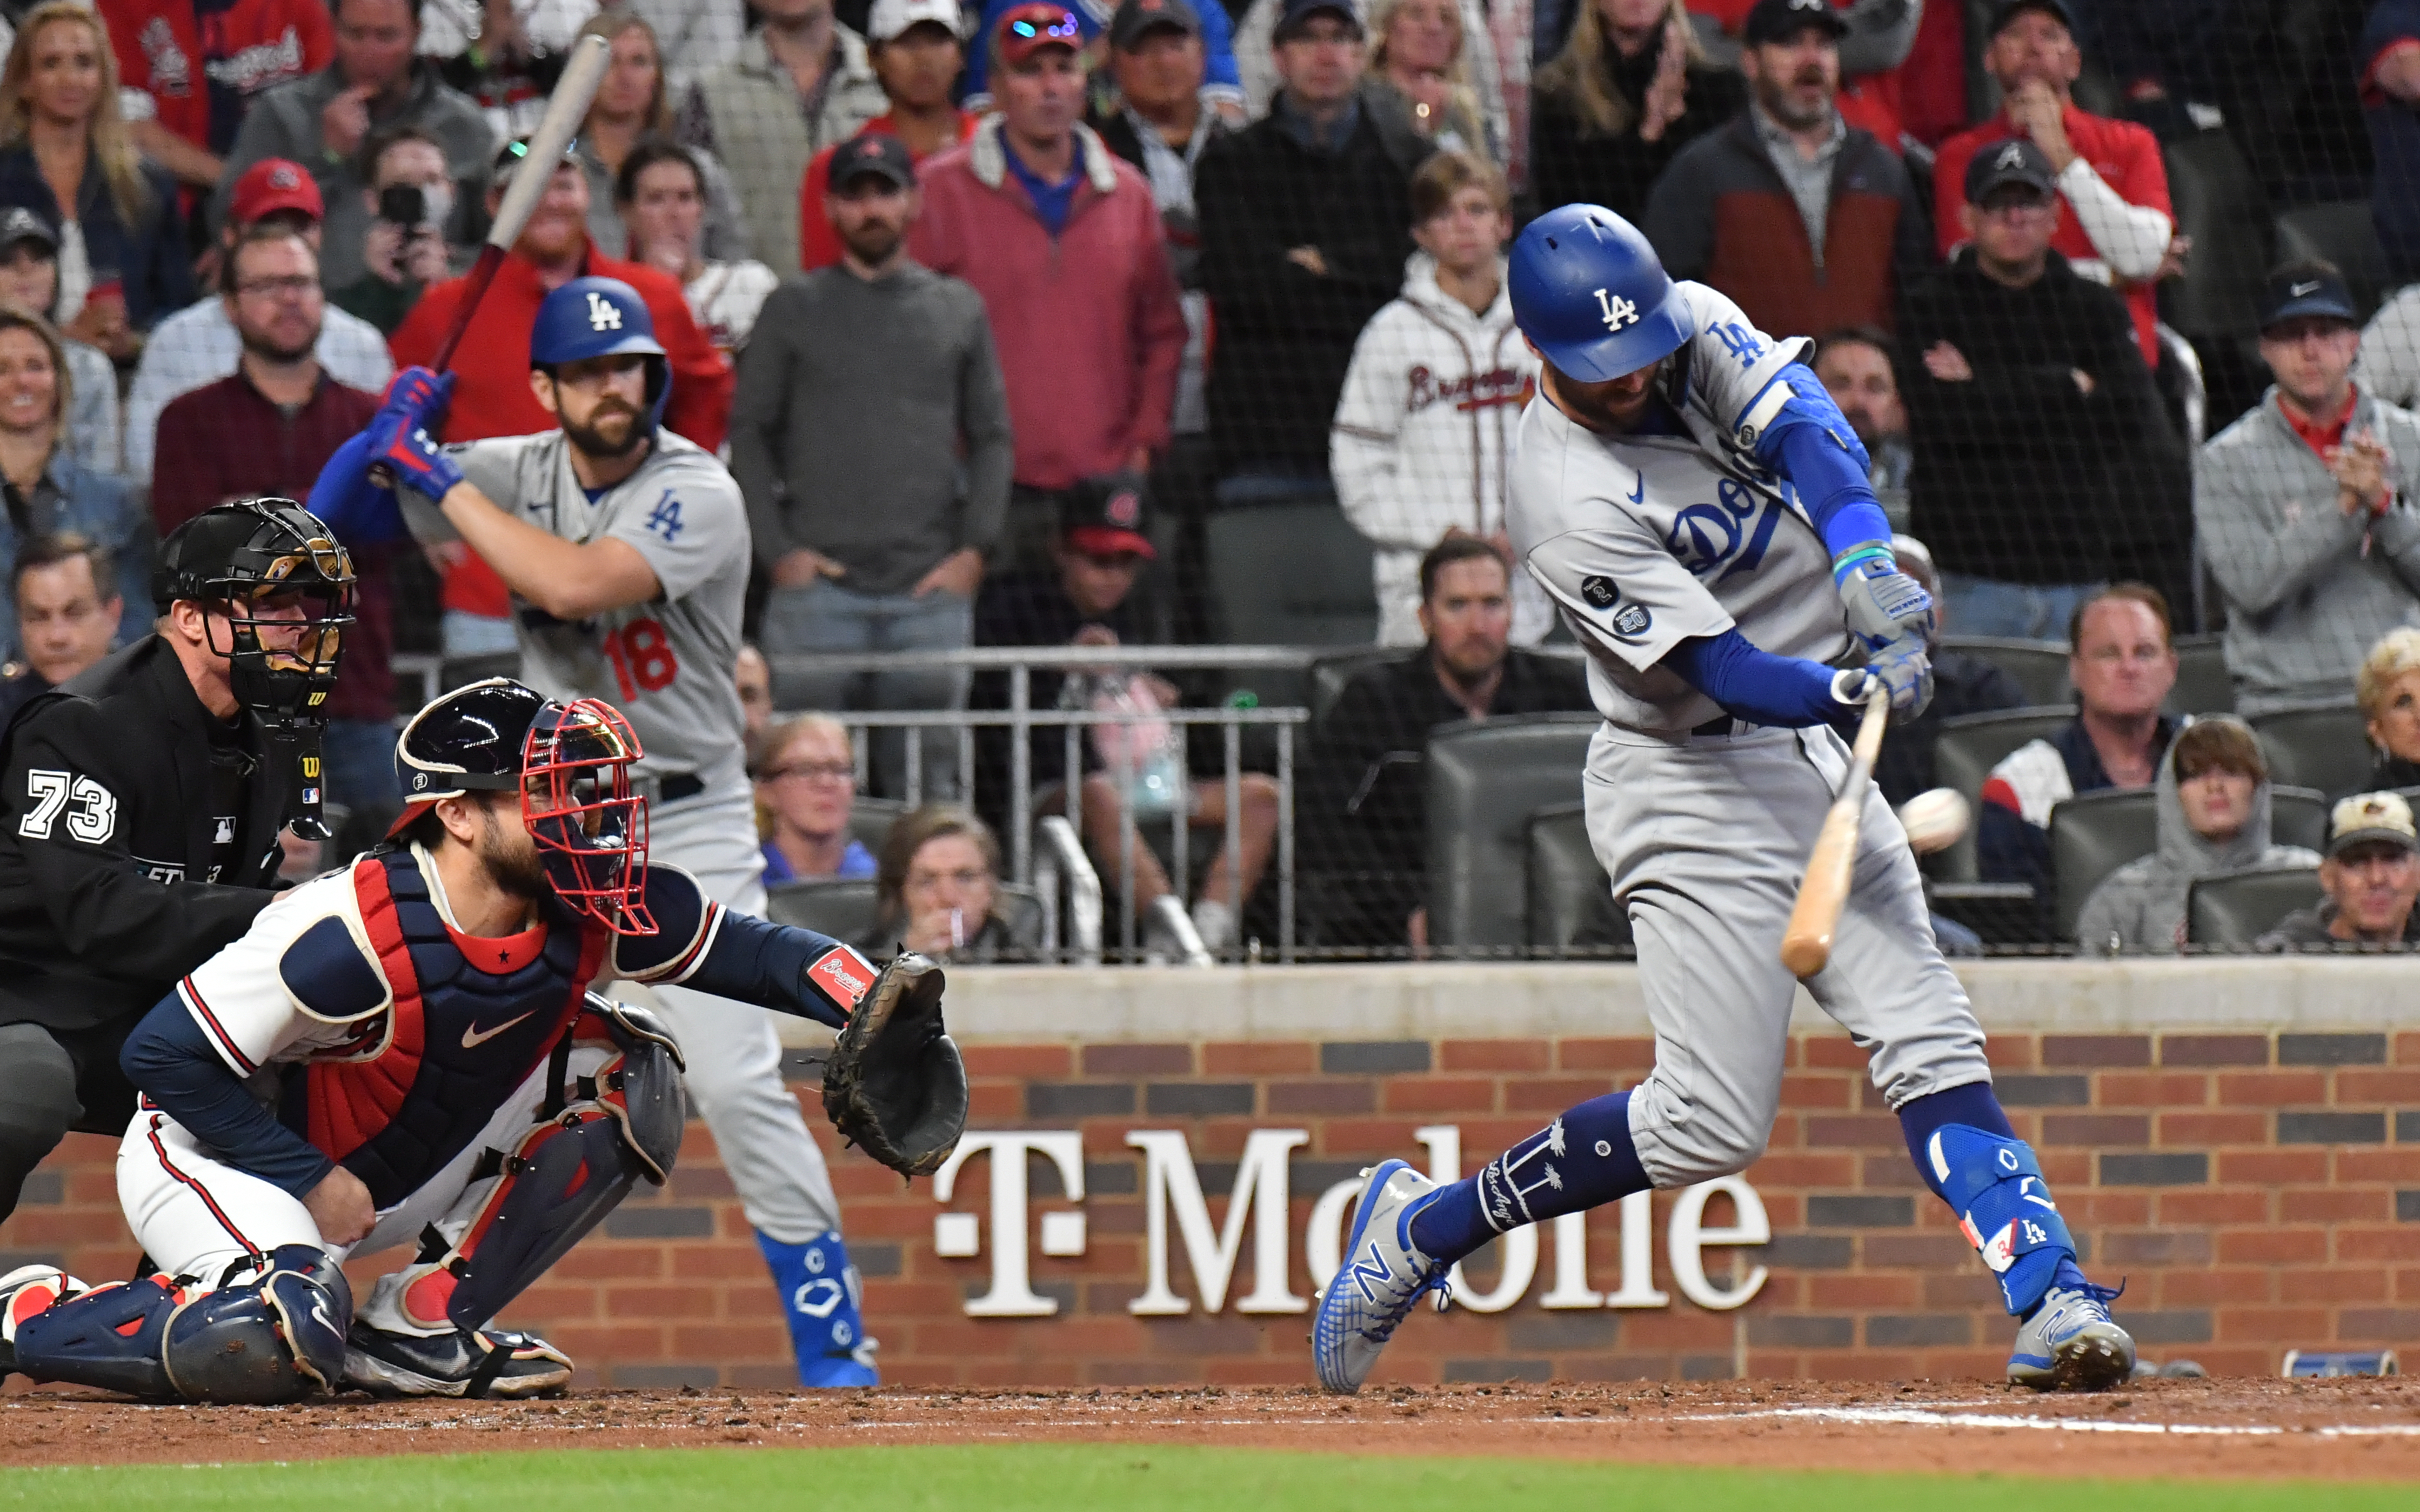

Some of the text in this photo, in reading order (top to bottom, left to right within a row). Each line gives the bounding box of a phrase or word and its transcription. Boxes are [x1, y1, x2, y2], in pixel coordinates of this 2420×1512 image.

[586, 292, 623, 331] LA
[1594, 288, 1640, 332] LA
[1705, 321, 1766, 367] LA
[646, 489, 683, 541] LA
[1594, 586, 1612, 603] 2
[1615, 605, 1639, 621] SUTTON
[1620, 611, 1647, 632] 20
[604, 617, 678, 703] 18
[18, 769, 117, 845] 73
[820, 958, 866, 989] Braves
[2022, 1219, 2047, 1245] LA
